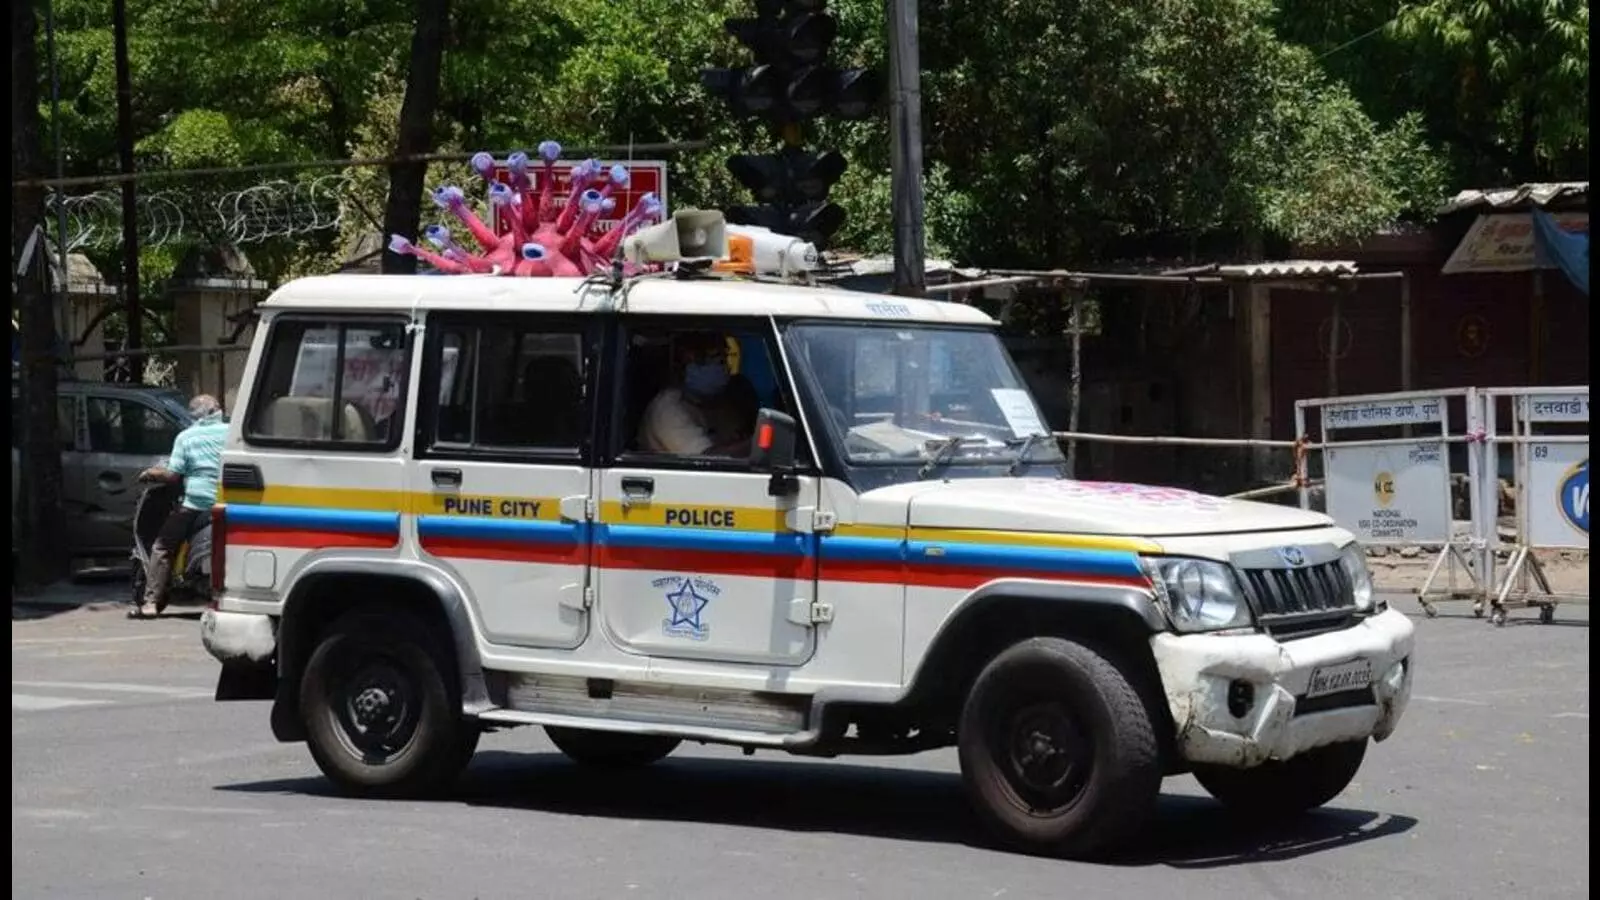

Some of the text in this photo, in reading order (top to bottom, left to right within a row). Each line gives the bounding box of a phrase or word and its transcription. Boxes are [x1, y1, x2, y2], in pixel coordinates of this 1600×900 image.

[444, 499, 541, 518] PUNE CITY
[665, 509, 736, 527] POLICE
